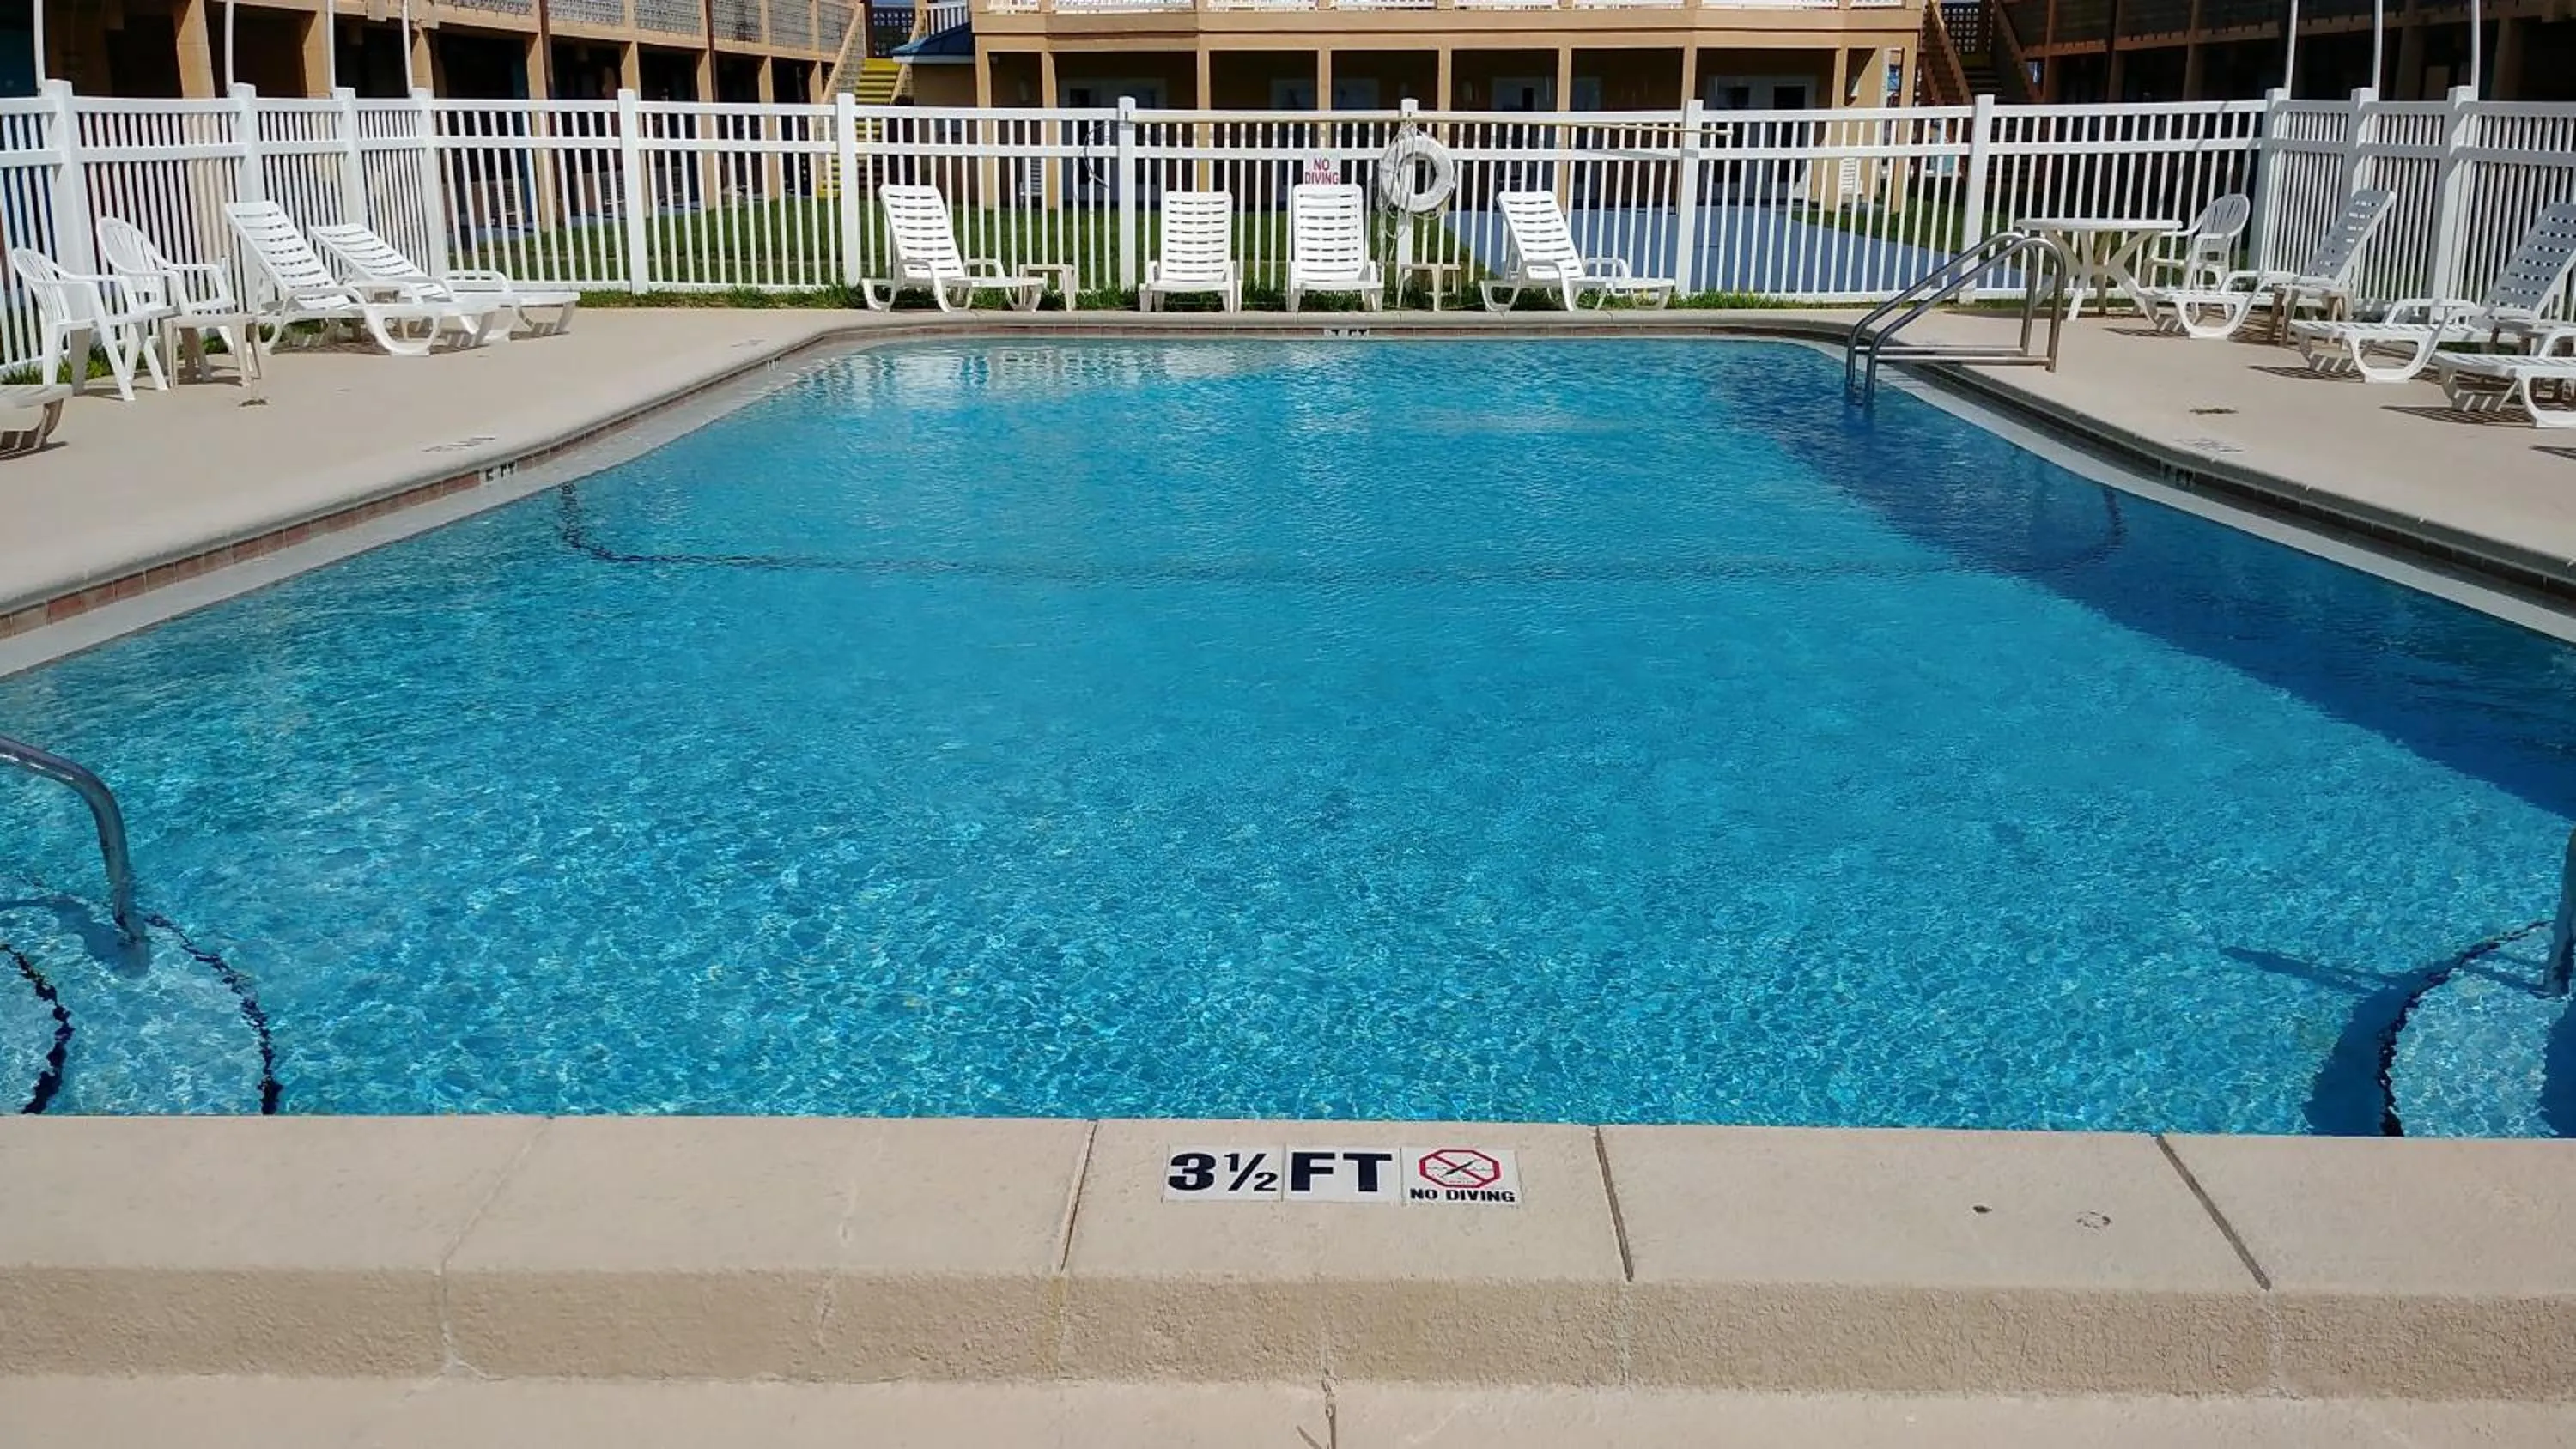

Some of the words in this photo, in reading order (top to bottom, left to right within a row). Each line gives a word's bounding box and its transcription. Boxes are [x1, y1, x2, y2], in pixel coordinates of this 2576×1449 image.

[1314, 157, 1330, 170] NO
[1304, 171, 1339, 185] DIVING
[1291, 1151, 1393, 1192] FT
[1409, 1188, 1438, 1200] NO
[1445, 1189, 1515, 1203] DIVING
